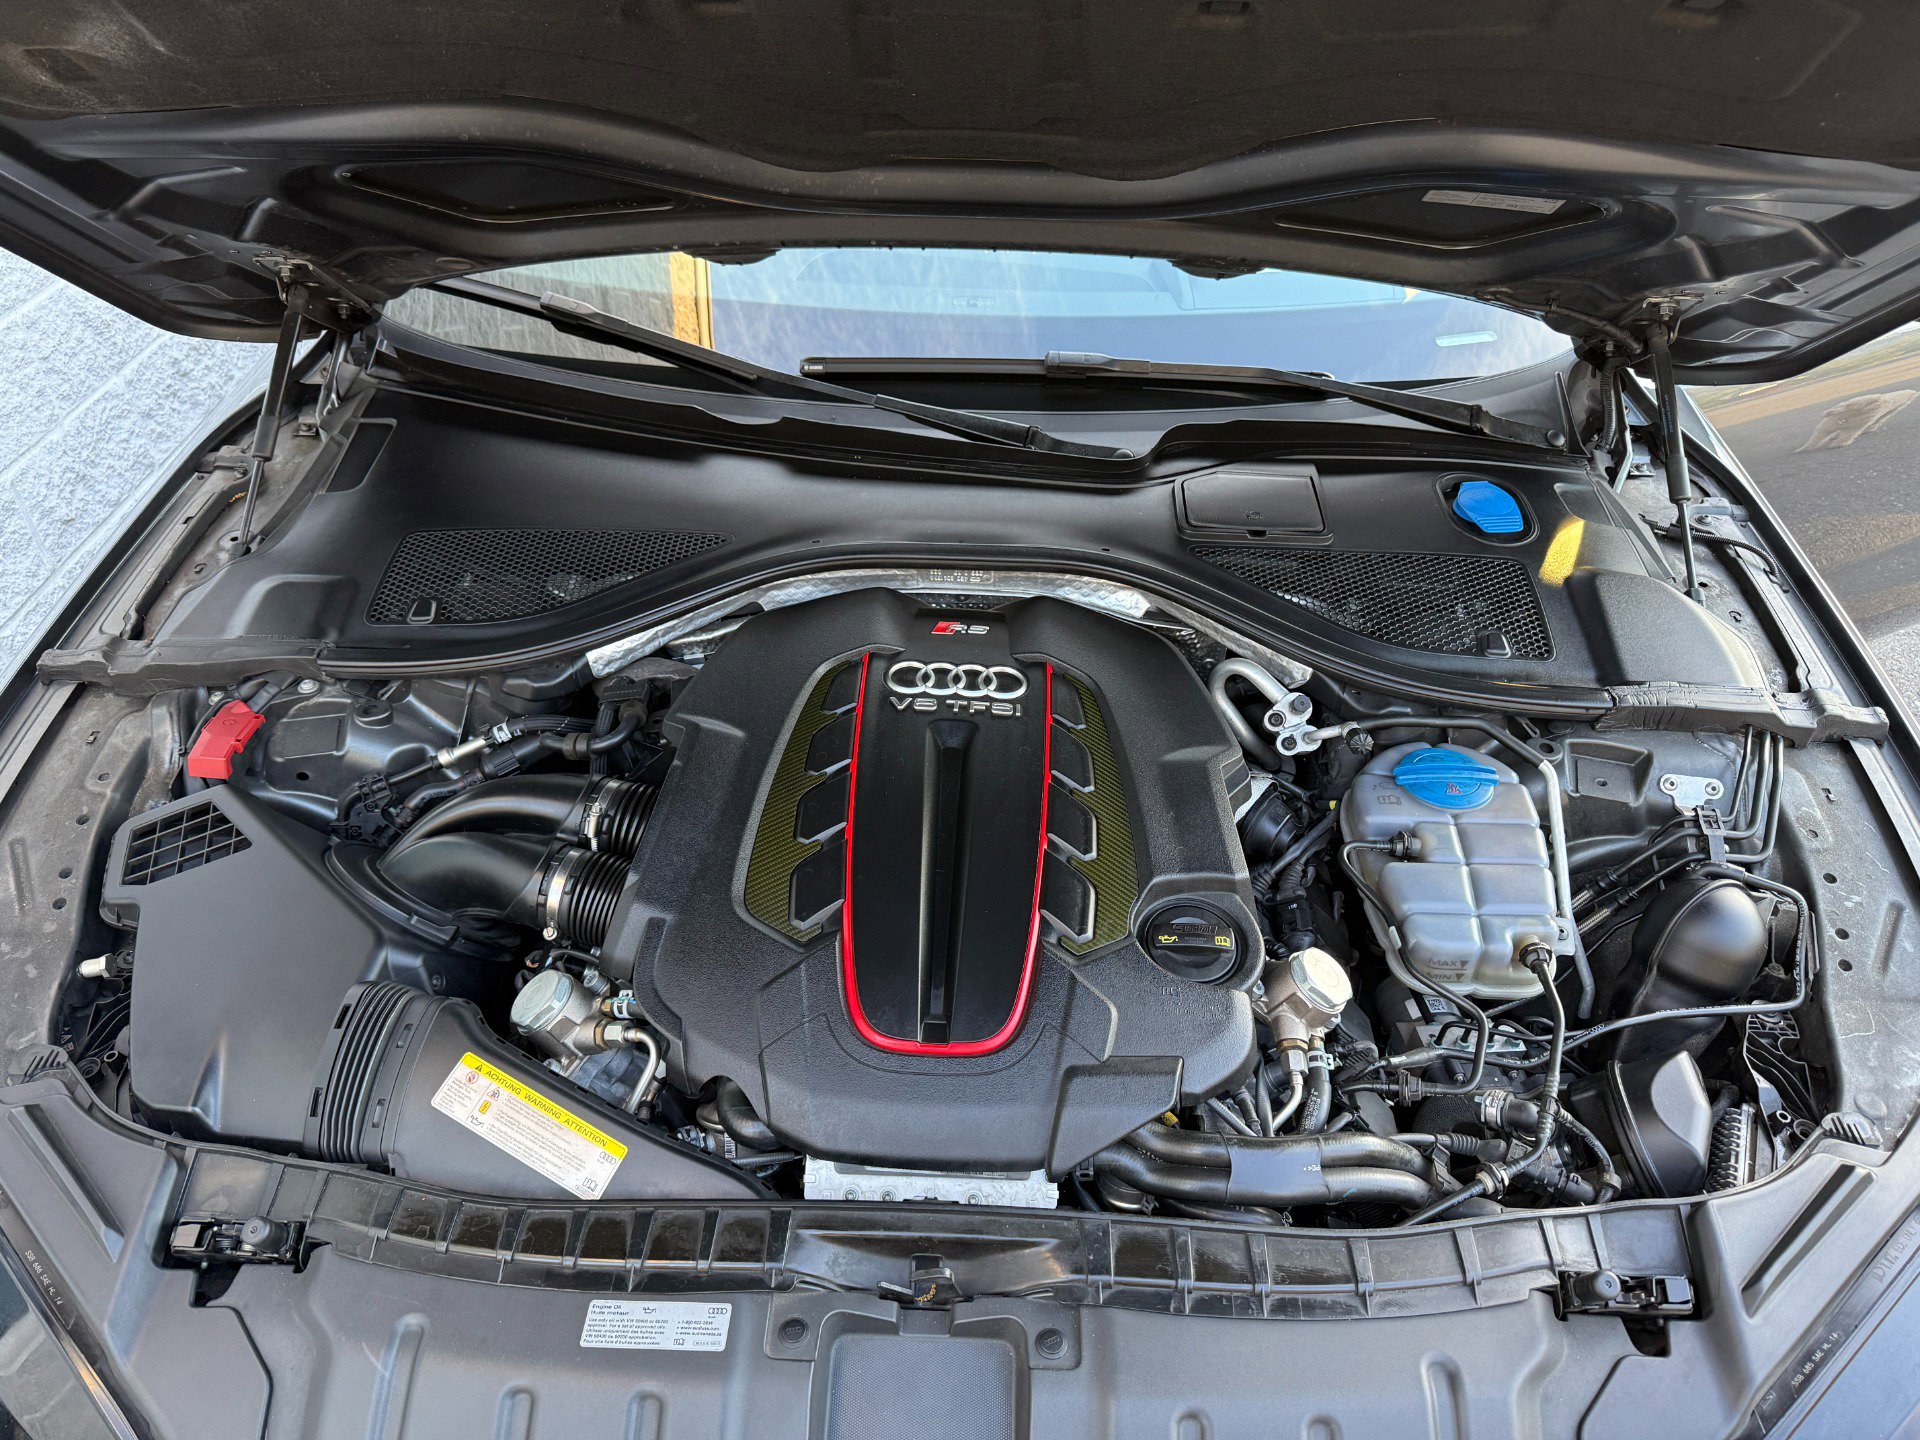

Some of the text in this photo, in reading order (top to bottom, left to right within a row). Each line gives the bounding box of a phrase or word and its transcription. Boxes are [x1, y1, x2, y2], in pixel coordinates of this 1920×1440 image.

[940, 622, 990, 635] RS
[889, 696, 1022, 717] V8 TFSI
[1428, 957, 1458, 967] MAX
[1426, 972, 1452, 980] MIN
[485, 1070, 522, 1095] ACHTUNG
[523, 1092, 562, 1120] WARNING
[564, 1118, 608, 1147] ATTENTION
[40, 1274, 52, 1286] SAE
[1802, 1361, 1815, 1374] 685
[1811, 1349, 1825, 1362] SAE
